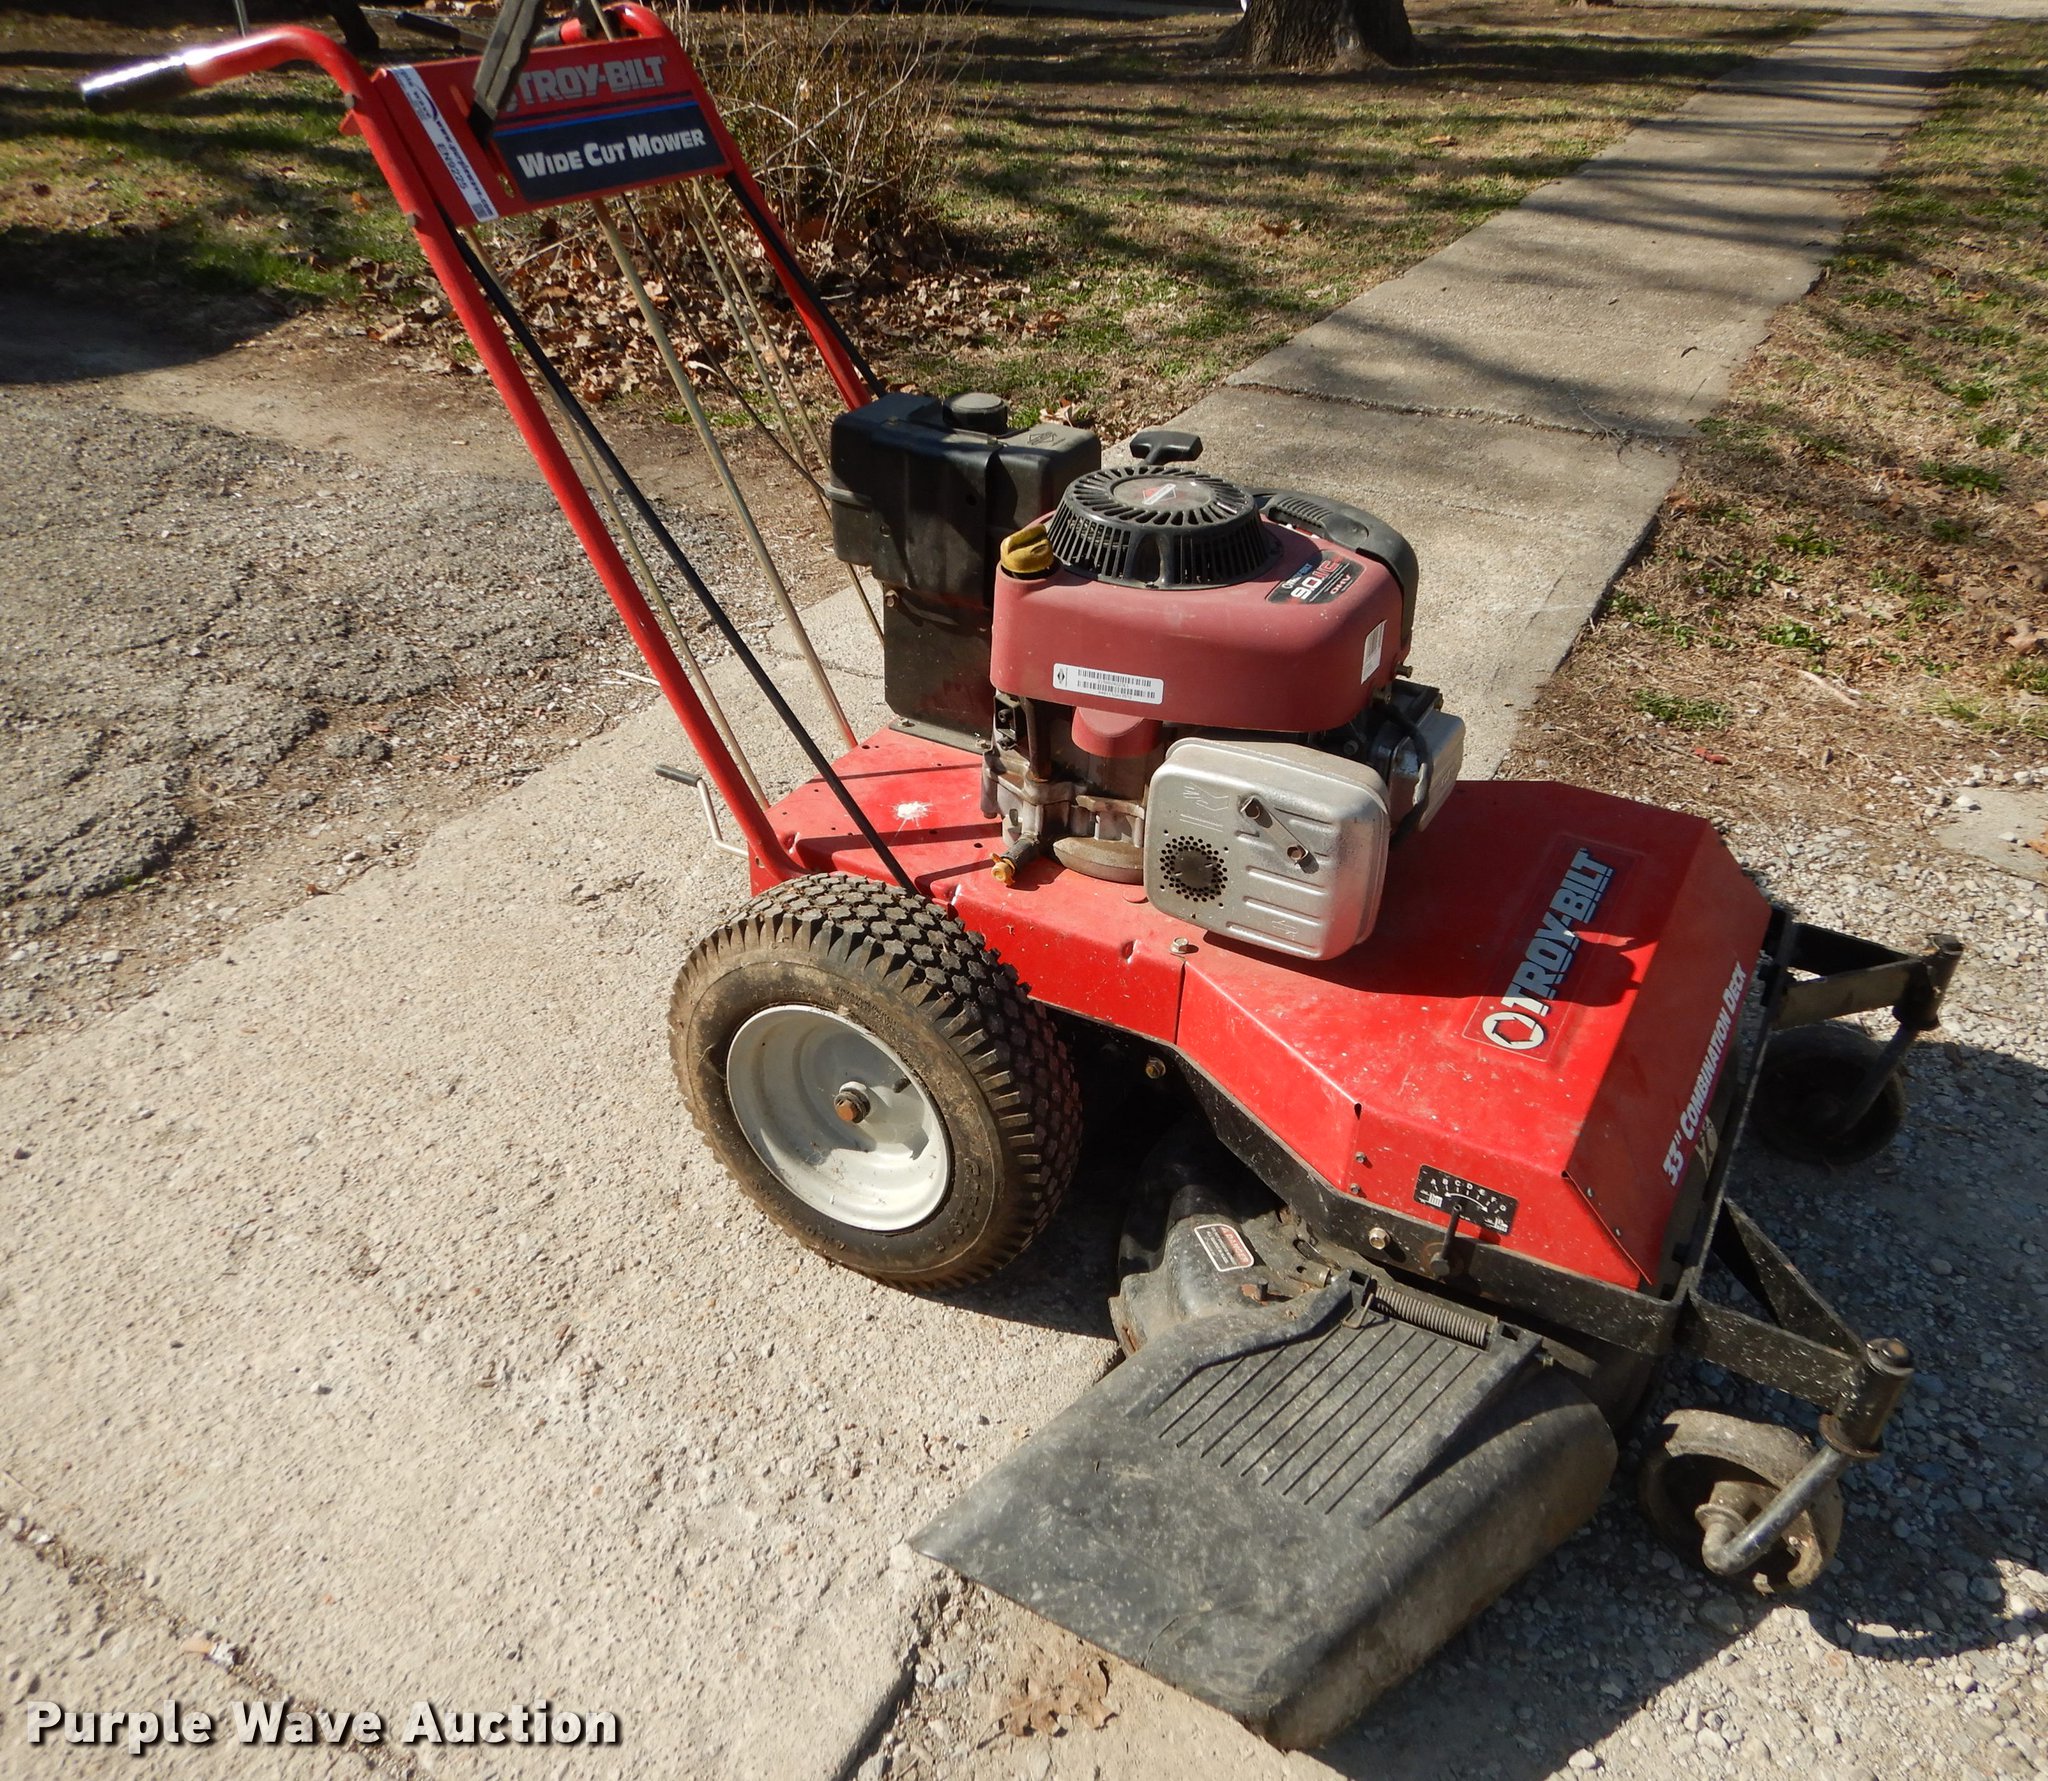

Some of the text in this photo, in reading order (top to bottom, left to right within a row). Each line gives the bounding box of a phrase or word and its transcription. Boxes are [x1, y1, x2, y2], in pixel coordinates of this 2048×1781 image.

[519, 56, 665, 104] TROY-BILT
[516, 128, 707, 179] WIDE CUT MOWER
[1330, 574, 1352, 595] OHV
[1501, 849, 1614, 1018] TROY-BILT
[1680, 1006, 1732, 1140] COMBINATION
[1722, 961, 1747, 1015] DECK
